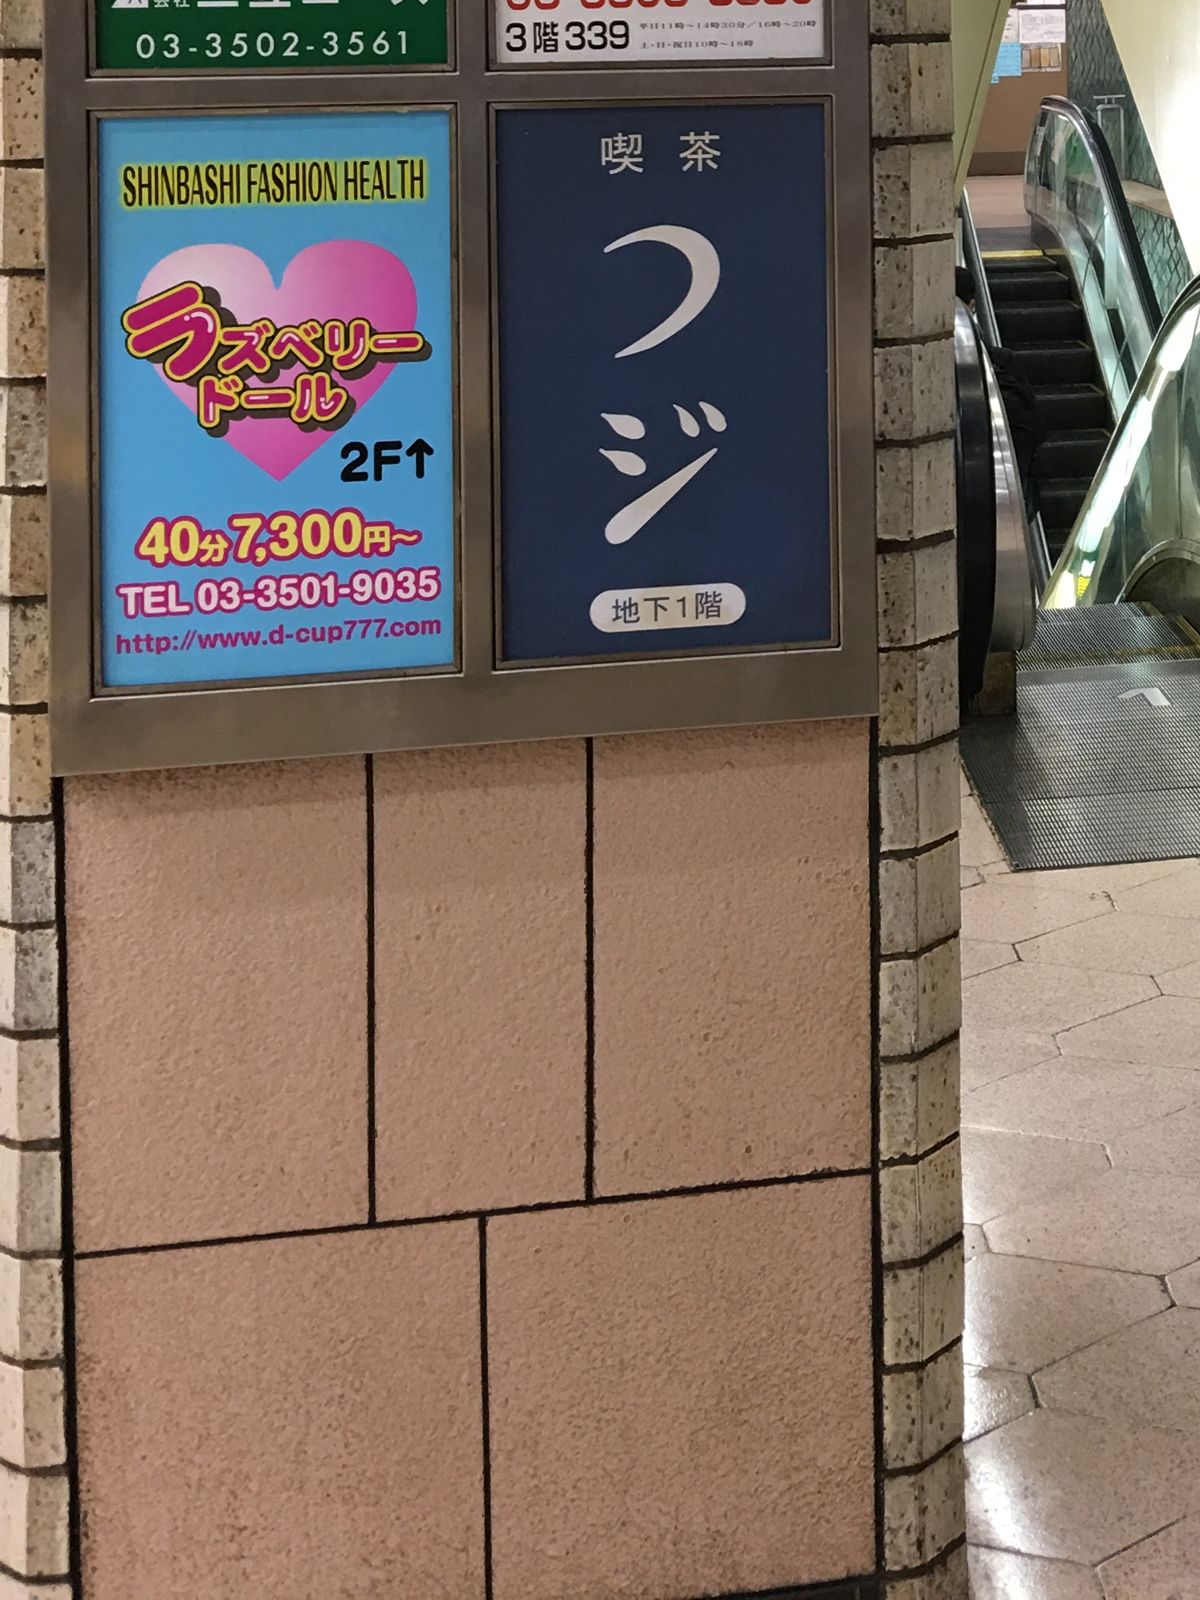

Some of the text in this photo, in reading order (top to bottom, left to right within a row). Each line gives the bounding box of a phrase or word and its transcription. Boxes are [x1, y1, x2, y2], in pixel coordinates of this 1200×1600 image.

[135, 29, 409, 59] 03-3502-3561
[504, 20, 631, 54] 3階339
[600, 130, 722, 175] 喫茶
[122, 158, 425, 208] SHINBASHI FASHION HEALTH
[121, 280, 427, 380] ラズベリー
[198, 371, 348, 429] ドール
[116, 566, 441, 619] TEL 03-3501-9035
[611, 590, 724, 625] 地下1階
[115, 618, 442, 655] http://www.d-cup777.com
